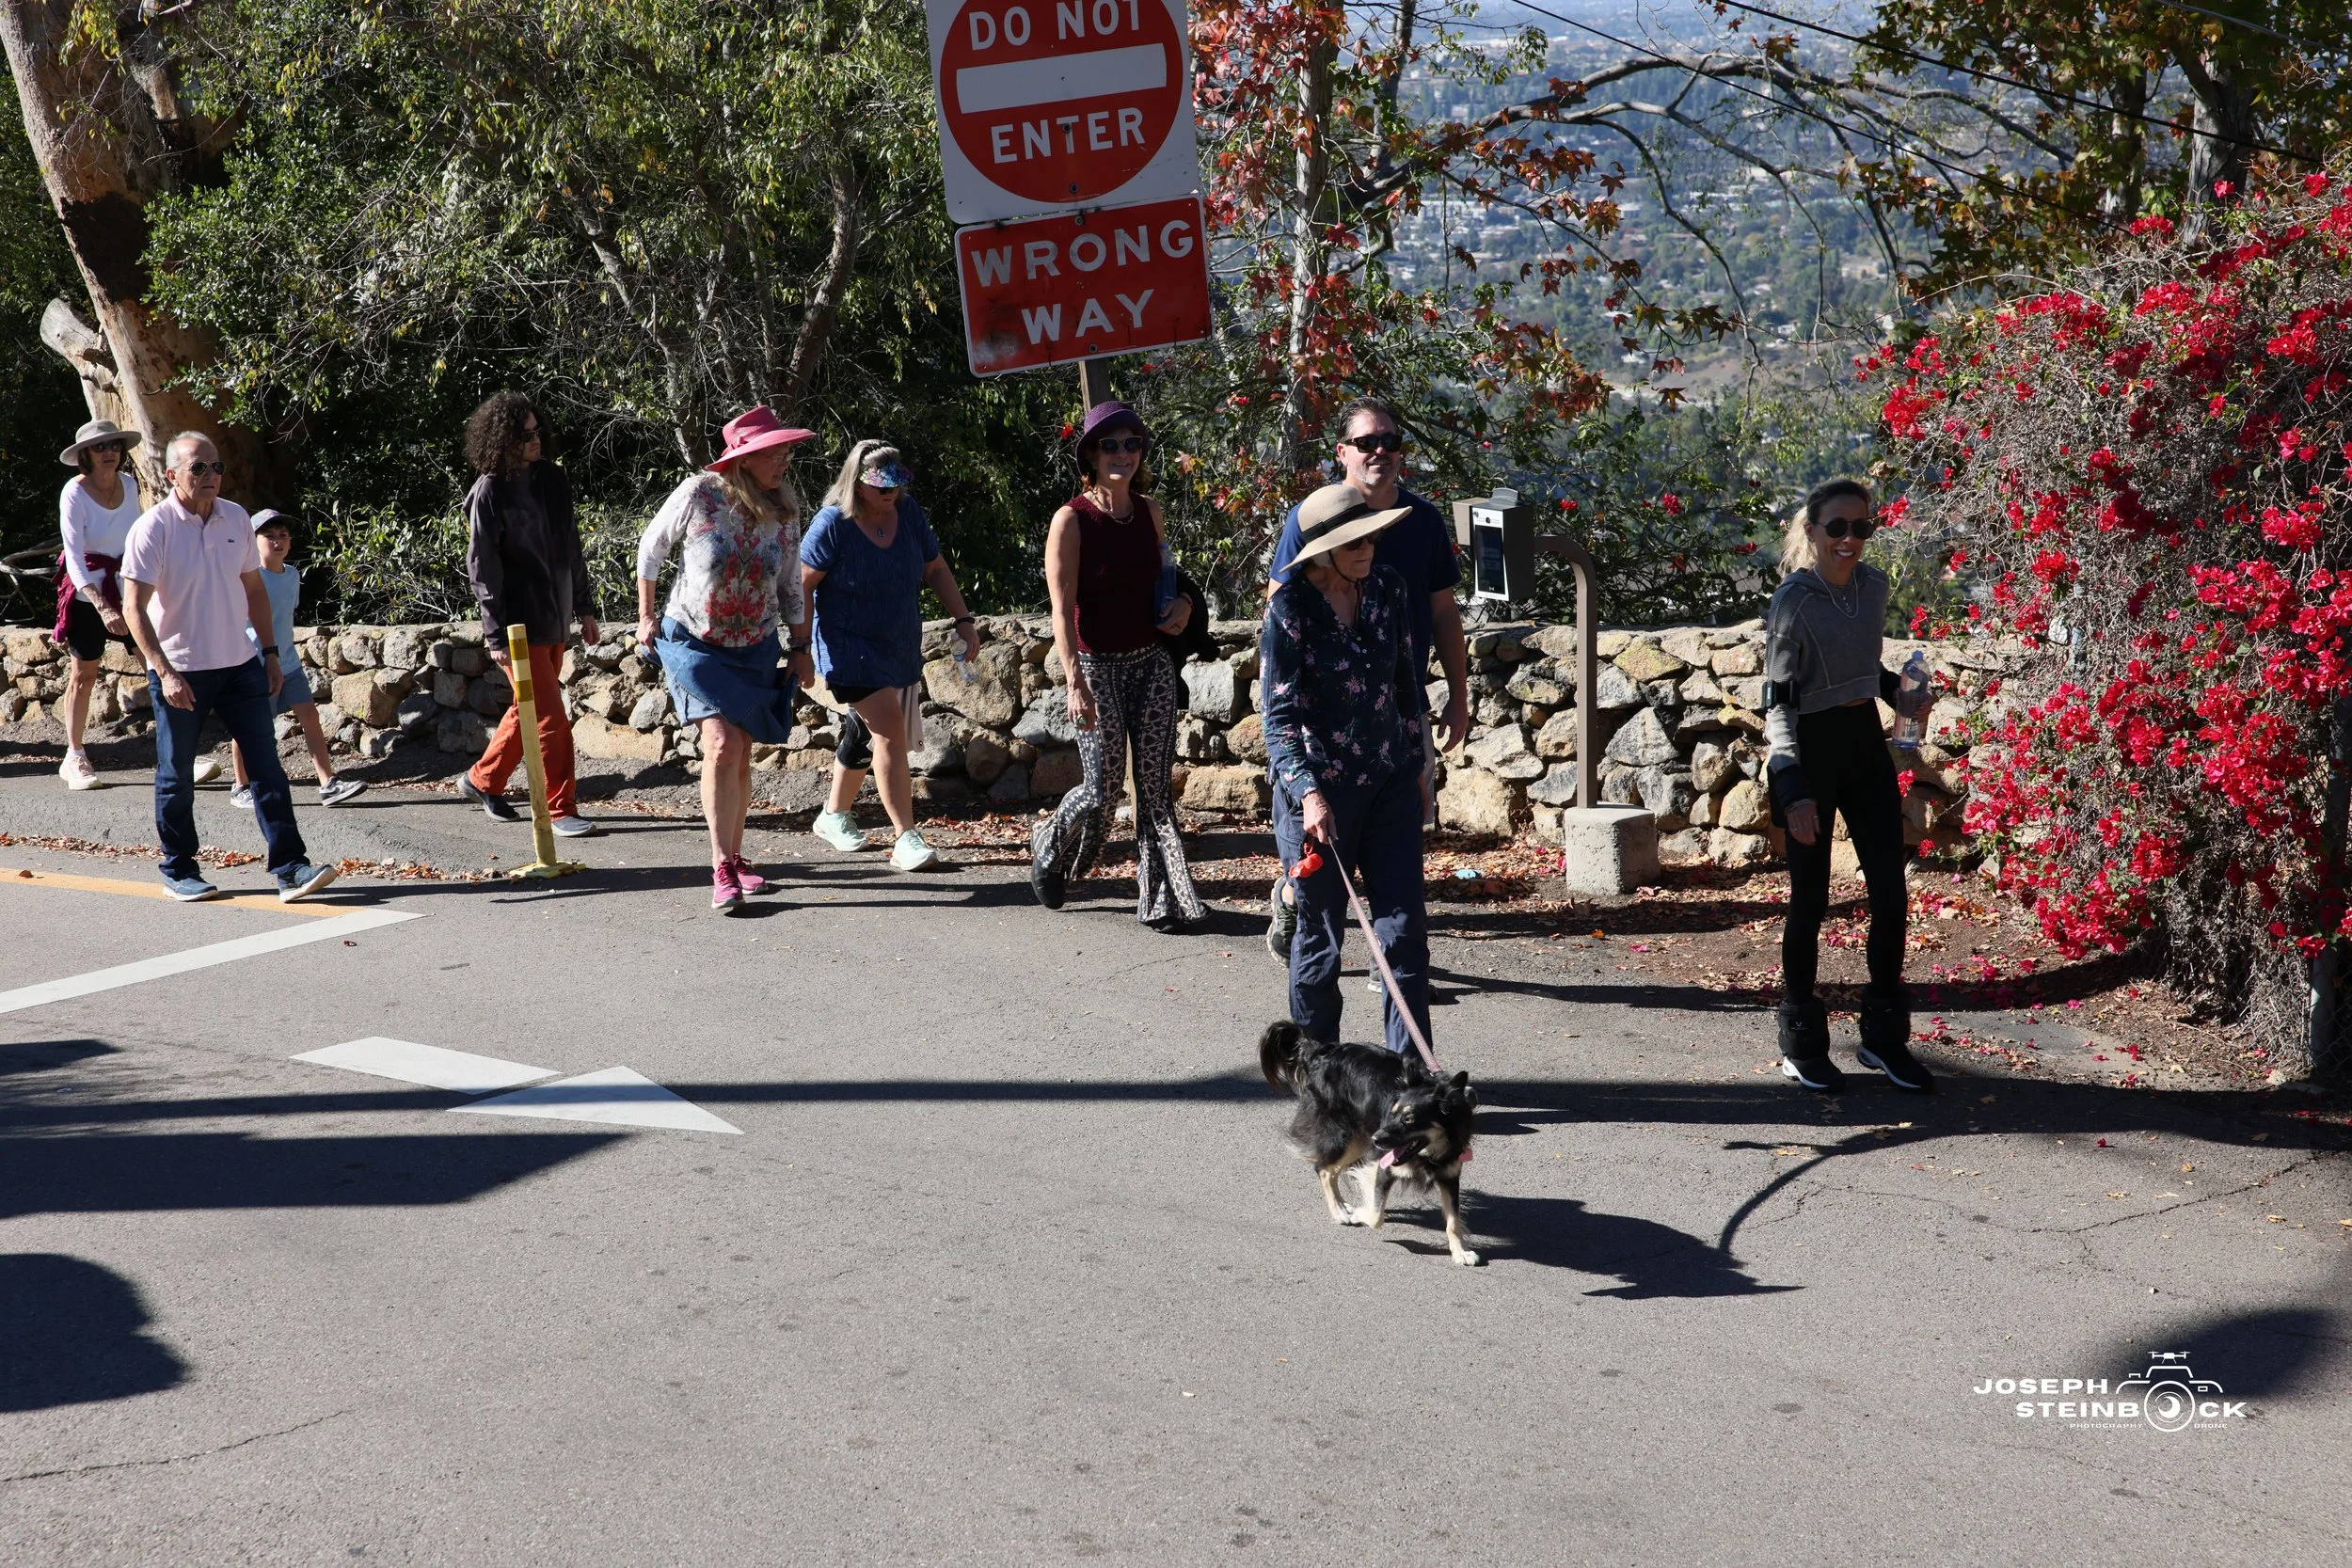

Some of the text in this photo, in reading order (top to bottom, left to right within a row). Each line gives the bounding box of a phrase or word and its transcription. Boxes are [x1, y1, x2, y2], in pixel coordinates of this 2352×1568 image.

[969, 0, 1139, 51] DO NOT
[991, 107, 1146, 165] ENTER
[971, 219, 1193, 288] WRONG
[1022, 289, 1154, 345] WAY
